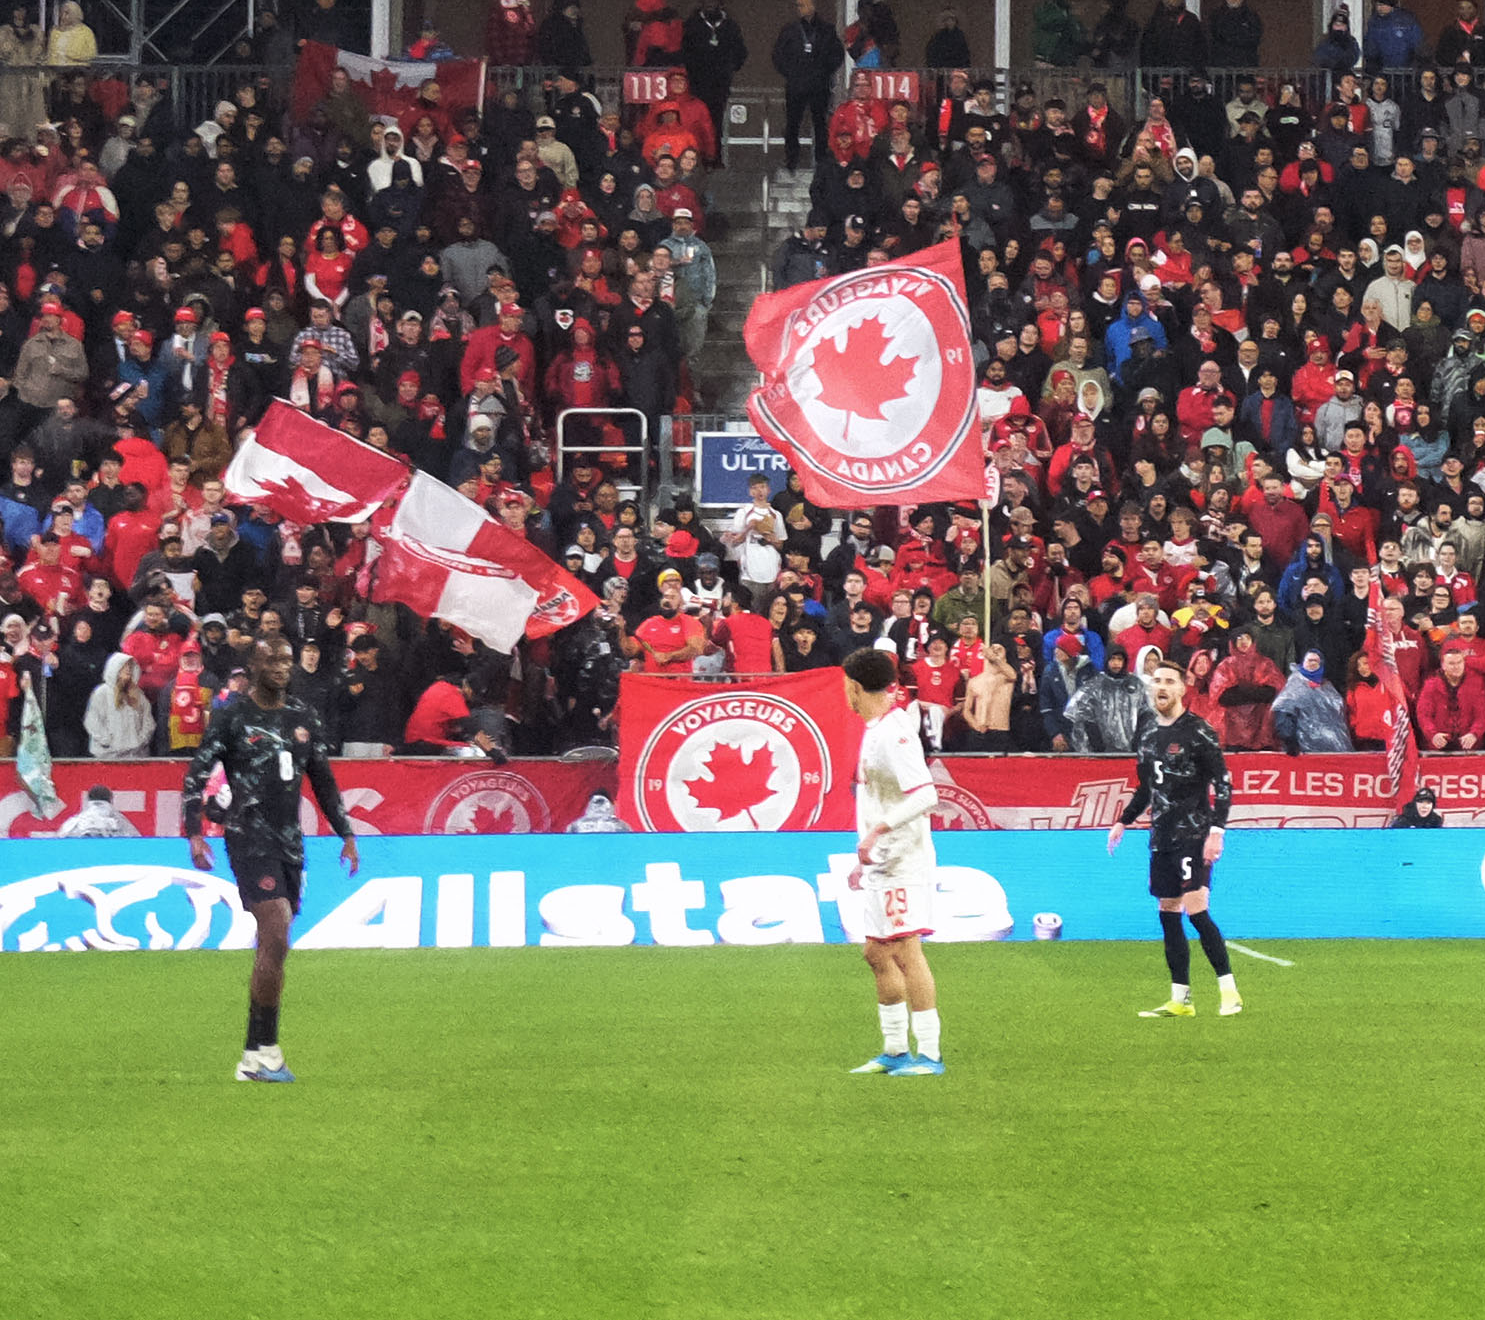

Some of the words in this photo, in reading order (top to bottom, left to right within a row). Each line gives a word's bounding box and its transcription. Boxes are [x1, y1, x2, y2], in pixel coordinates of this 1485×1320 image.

[630, 75, 669, 100] 113
[875, 75, 911, 99] 114
[670, 700, 798, 737] VOYAGEURS
[802, 771, 821, 785] 96
[1153, 760, 1164, 785] 5
[1288, 771, 1345, 797] LES
[647, 777, 664, 793] 19
[1181, 856, 1193, 880] 5
